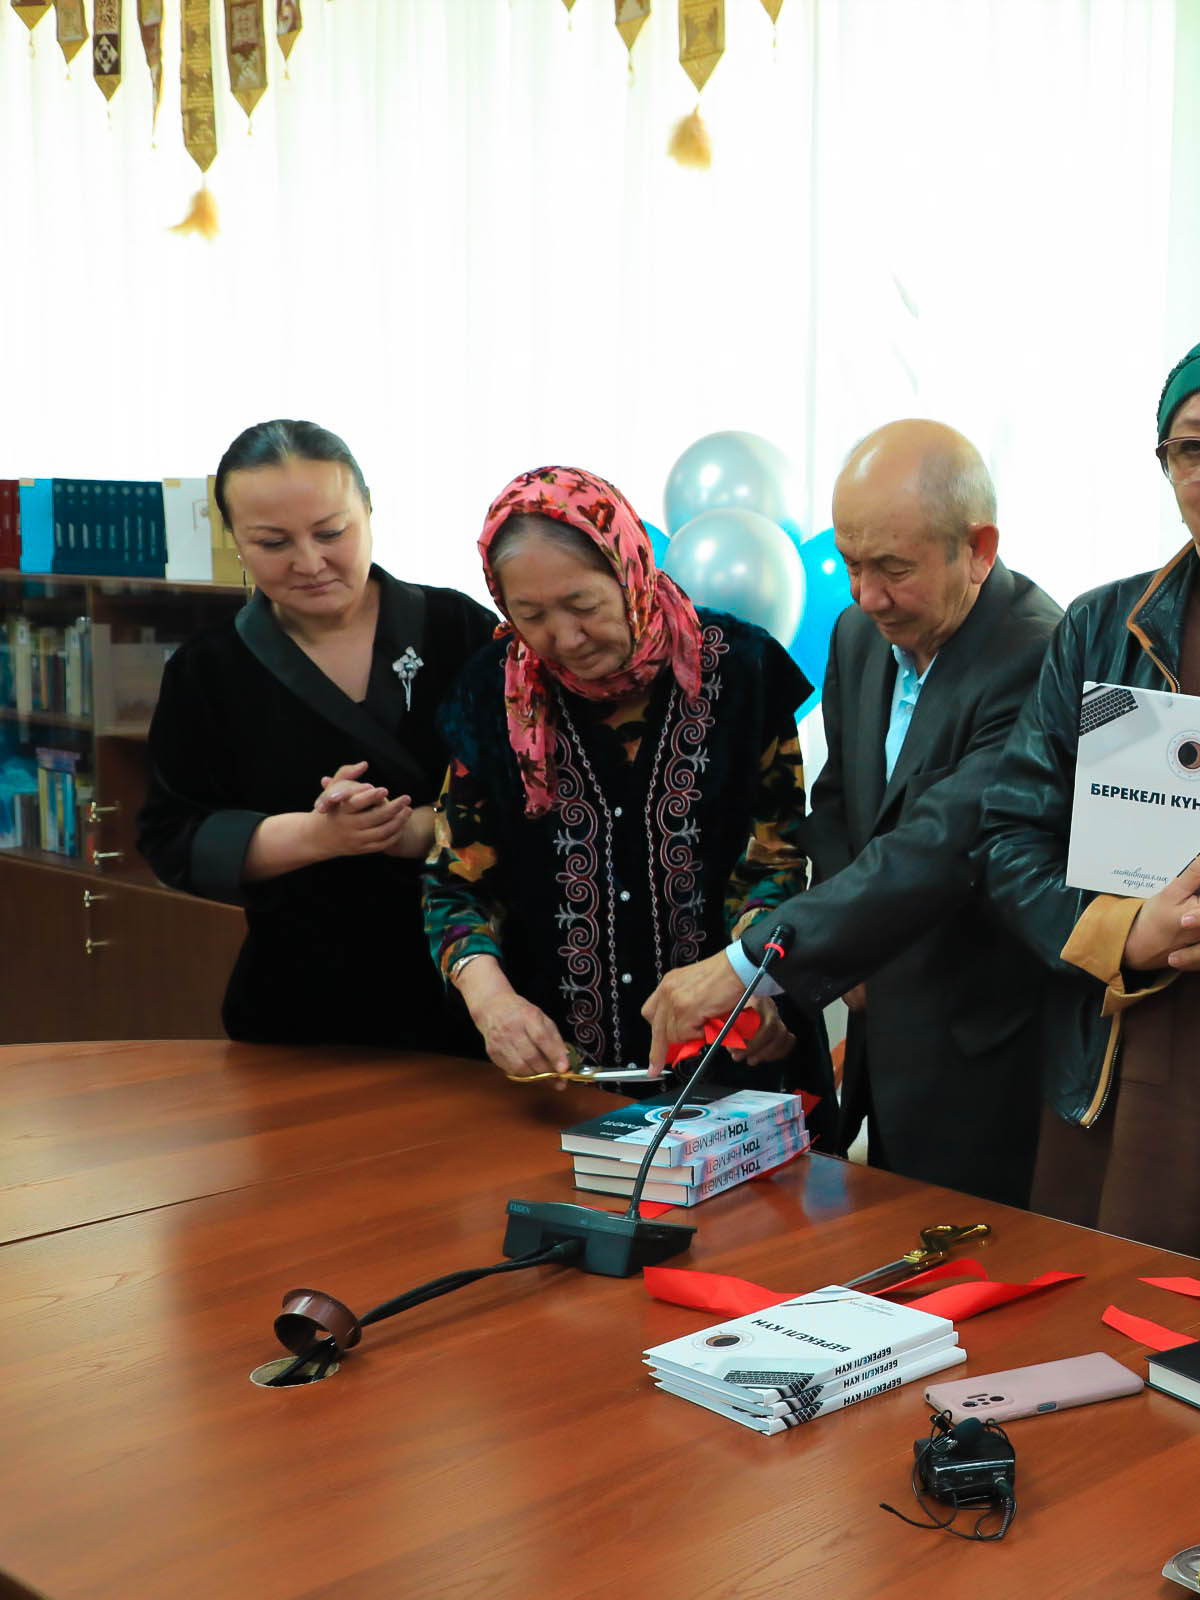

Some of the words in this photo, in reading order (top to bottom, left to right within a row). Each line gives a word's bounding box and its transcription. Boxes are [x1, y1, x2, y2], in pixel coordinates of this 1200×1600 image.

[1090, 782, 1166, 806] БЕРЕКЕЛІ
[750, 1318, 785, 1332] КҮН
[782, 1329, 851, 1353] БЕРЕКЕЛІ
[854, 1346, 892, 1368] БЕРЕКЕЛІ
[834, 1361, 853, 1376] КҮН
[861, 1359, 898, 1381] БЕРЕКЕЛІ
[843, 1375, 860, 1389] КҮН
[863, 1376, 902, 1398] БЕРЕКЕЛІ
[843, 1392, 861, 1406] КҮН
